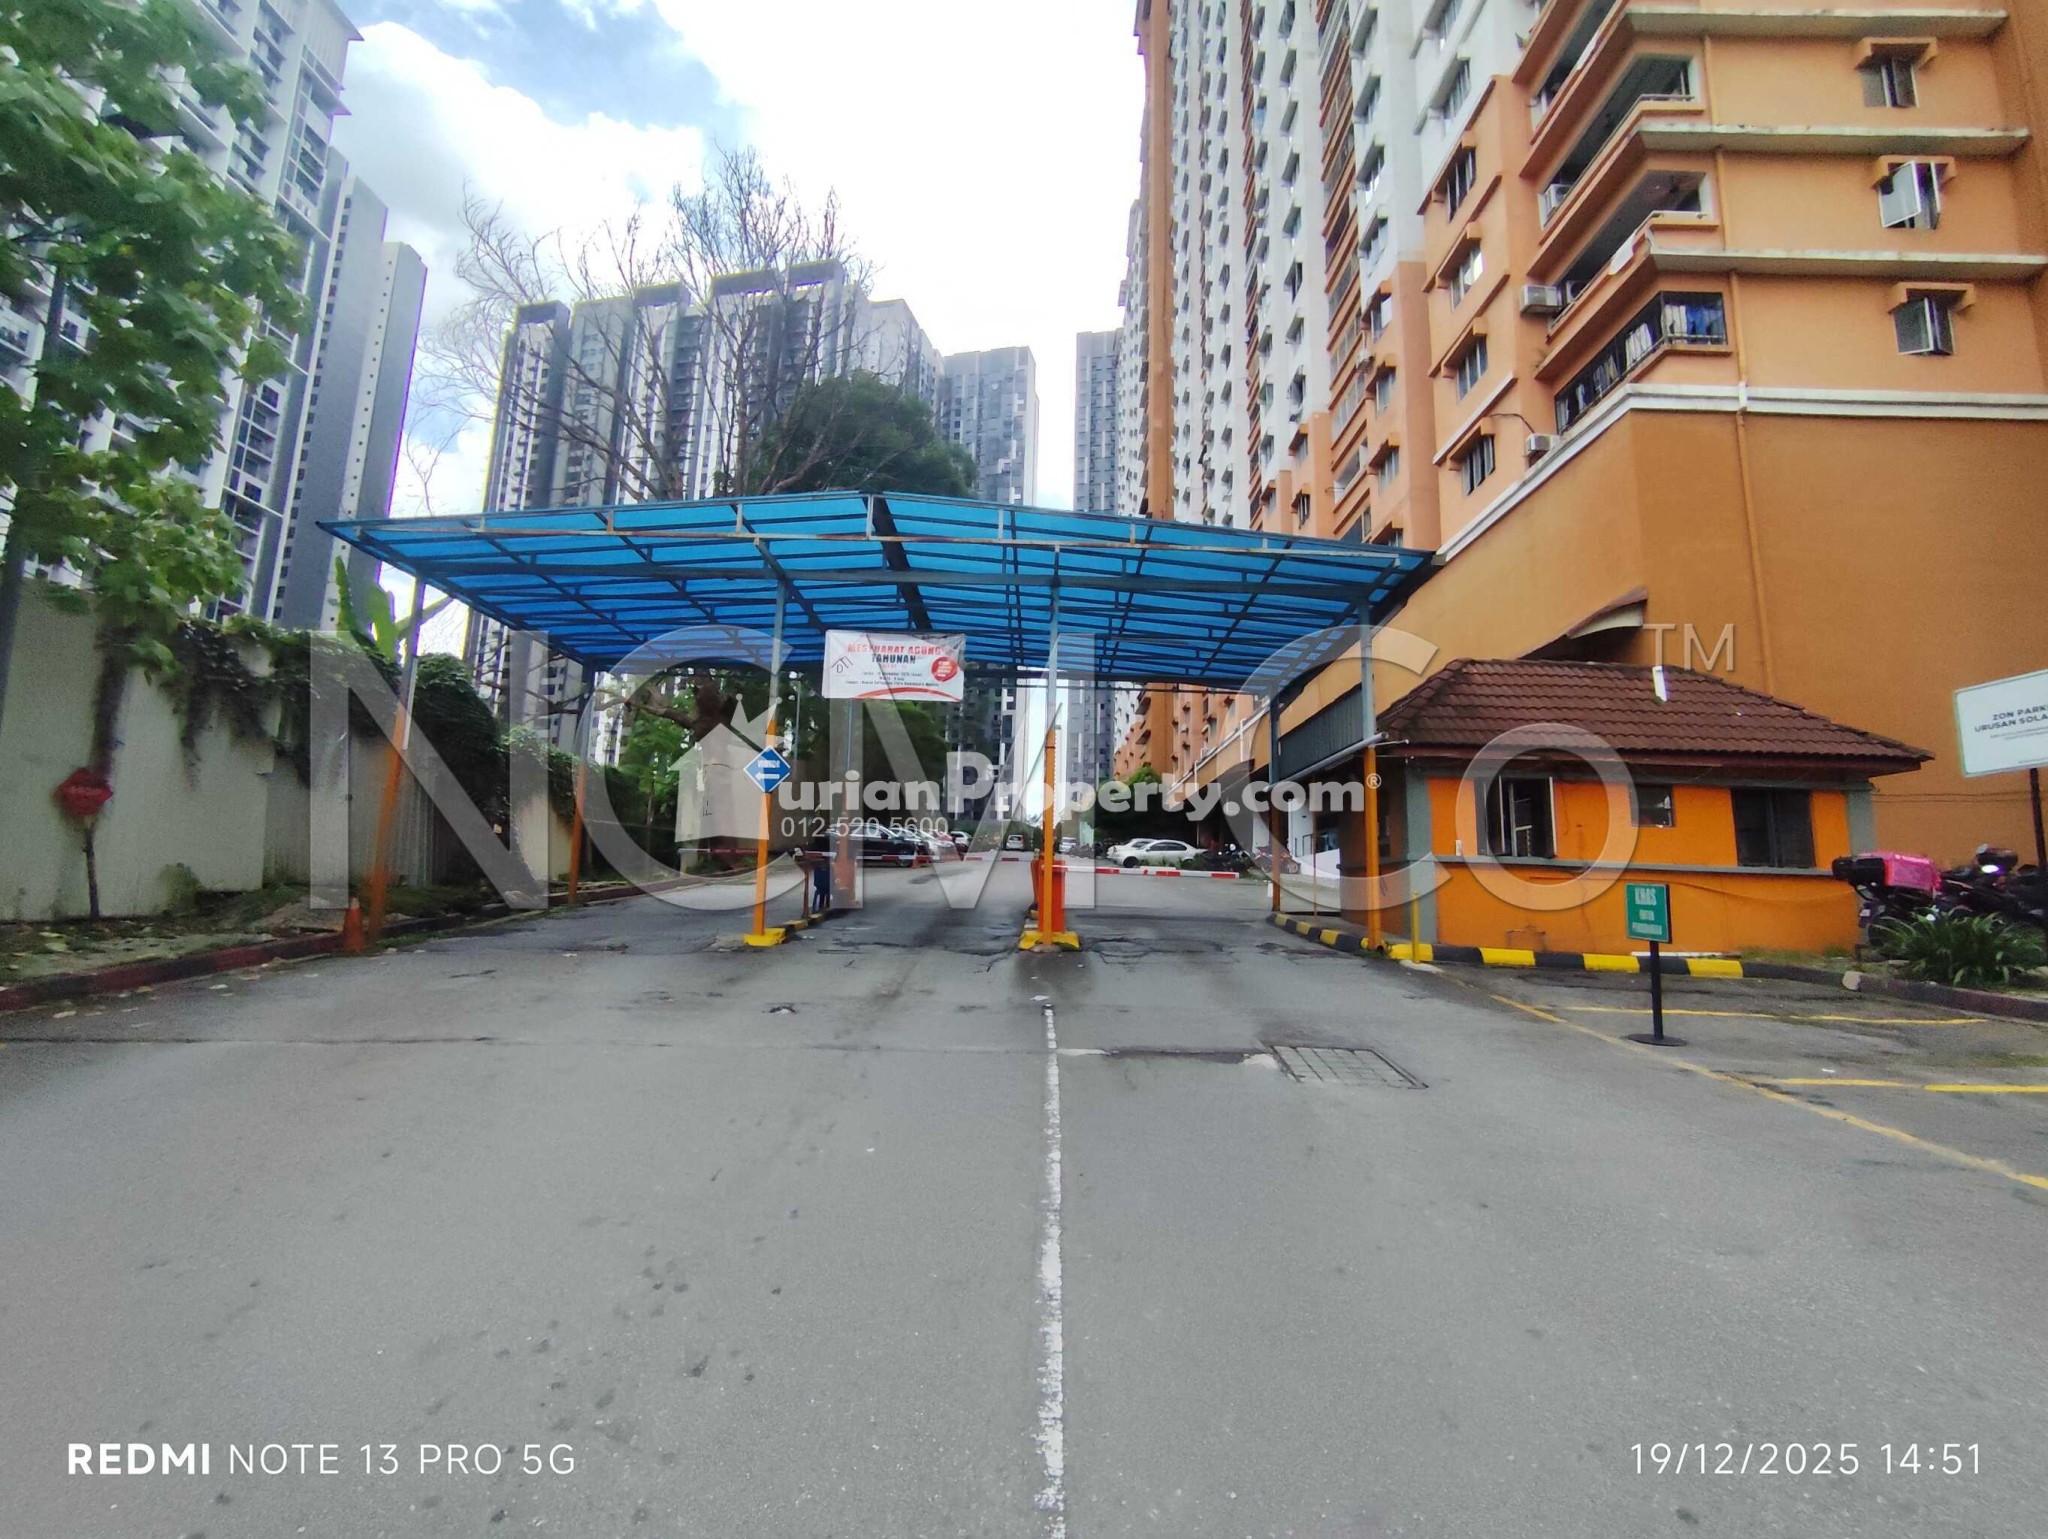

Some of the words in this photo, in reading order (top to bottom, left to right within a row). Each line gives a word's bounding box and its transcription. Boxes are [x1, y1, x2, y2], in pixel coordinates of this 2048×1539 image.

[871, 653, 916, 664] TAHUNAN
[1992, 711, 2014, 721] ZON
[1974, 719, 2016, 733] URUSAN
